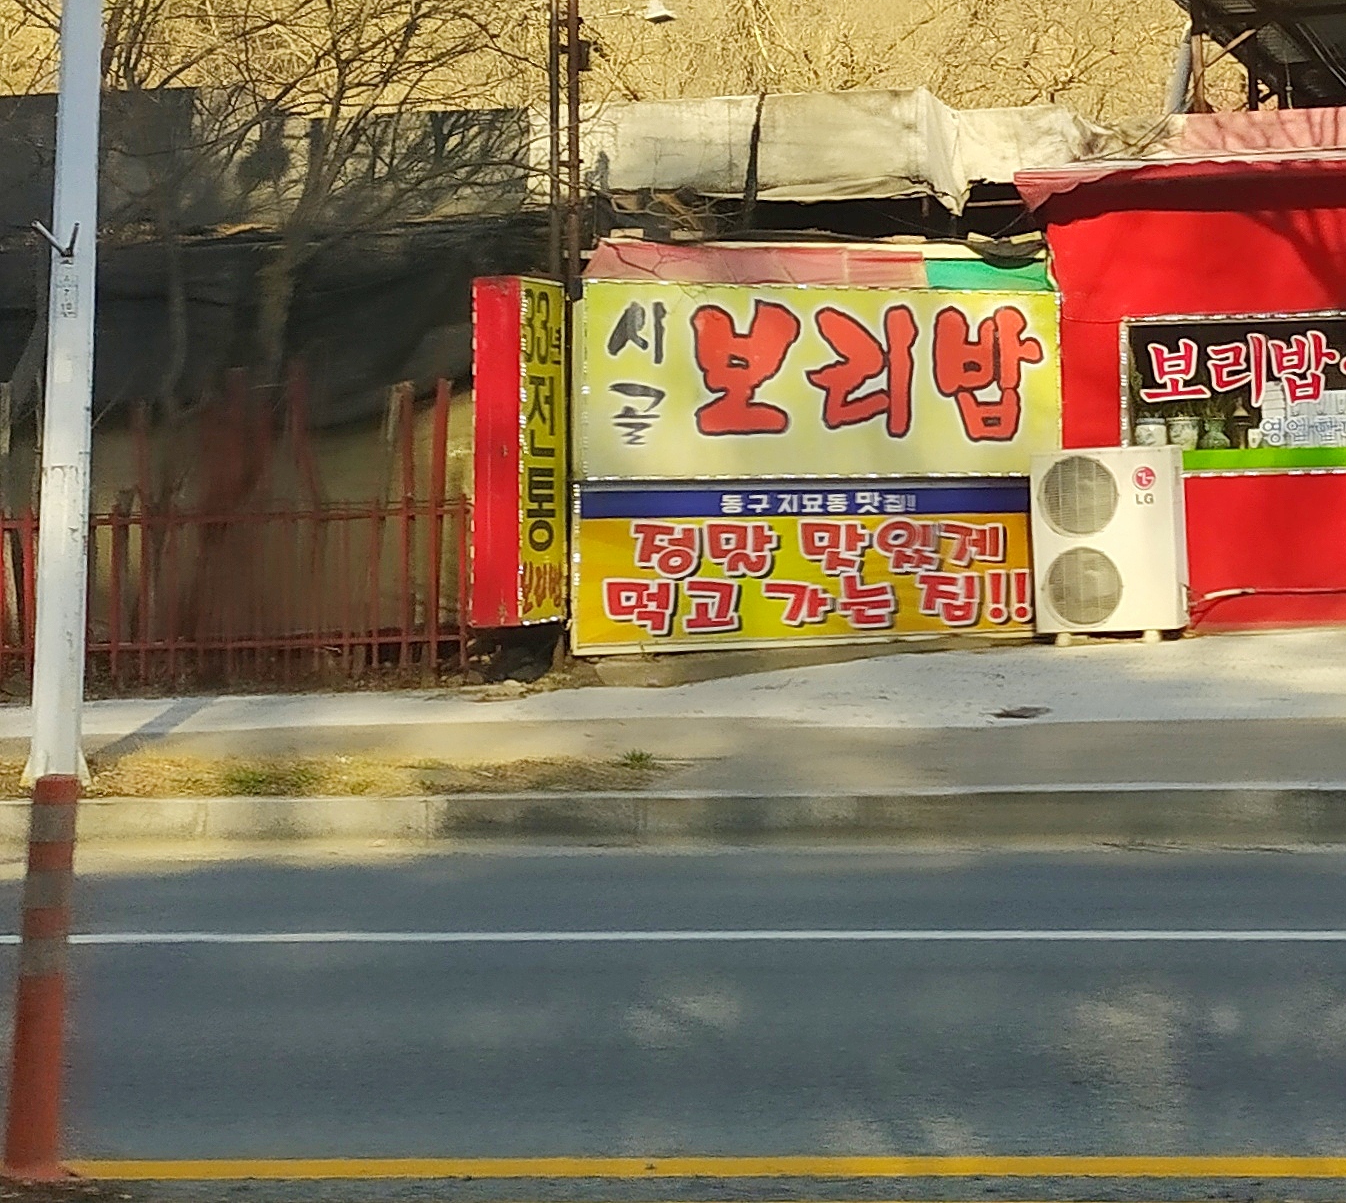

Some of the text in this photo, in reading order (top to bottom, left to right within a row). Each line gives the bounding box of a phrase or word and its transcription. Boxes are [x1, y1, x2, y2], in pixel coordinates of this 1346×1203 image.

[607, 301, 667, 445] 시골
[690, 299, 1044, 442] 보리밥
[525, 374, 558, 553] 전통
[720, 493, 770, 514] 동구
[777, 493, 848, 513] 지묘동
[1135, 493, 1154, 505] LG
[632, 521, 779, 577] 정말
[602, 569, 1035, 636] 먹고 가는 집!!
